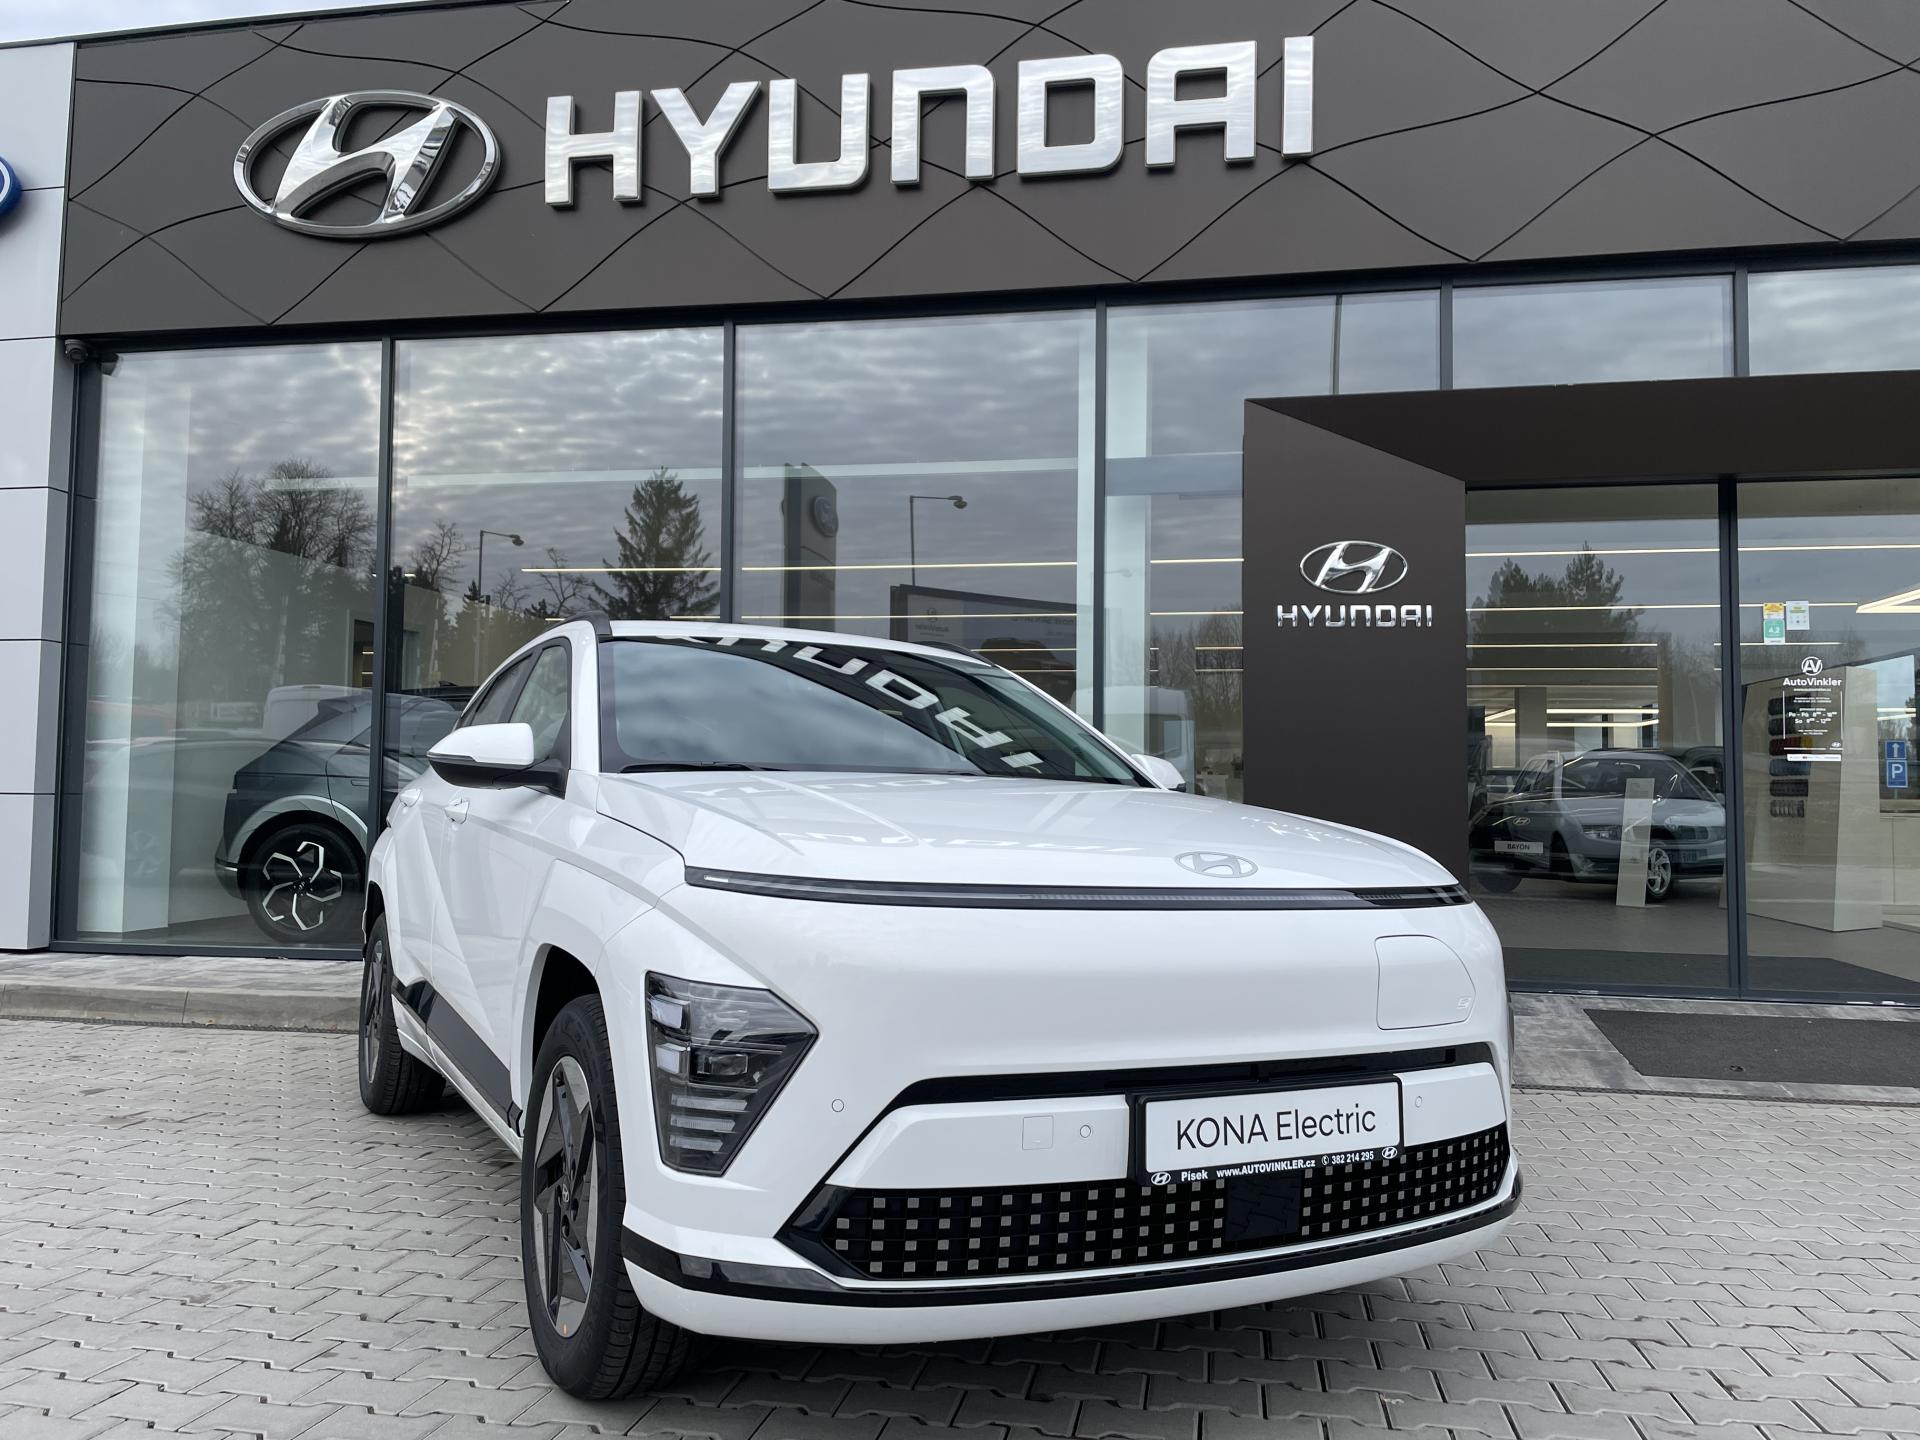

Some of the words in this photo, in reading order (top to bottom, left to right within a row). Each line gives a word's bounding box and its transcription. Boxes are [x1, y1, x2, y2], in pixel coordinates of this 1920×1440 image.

[544, 35, 1315, 206] HYUNDAI
[1276, 604, 1432, 627] HYUNDAI
[1783, 678, 1842, 687] AutoVinkler
[1891, 763, 1904, 779] P
[1177, 1112, 1268, 1150] KONA
[1276, 1103, 1376, 1140] Electric
[1181, 1169, 1209, 1182] Písek
[1216, 1159, 1316, 1178] www.AUTOVINKLER.cz
[1331, 1154, 1345, 1165] 382
[1346, 1152, 1359, 1164] 214
[1360, 1150, 1374, 1162] 295
